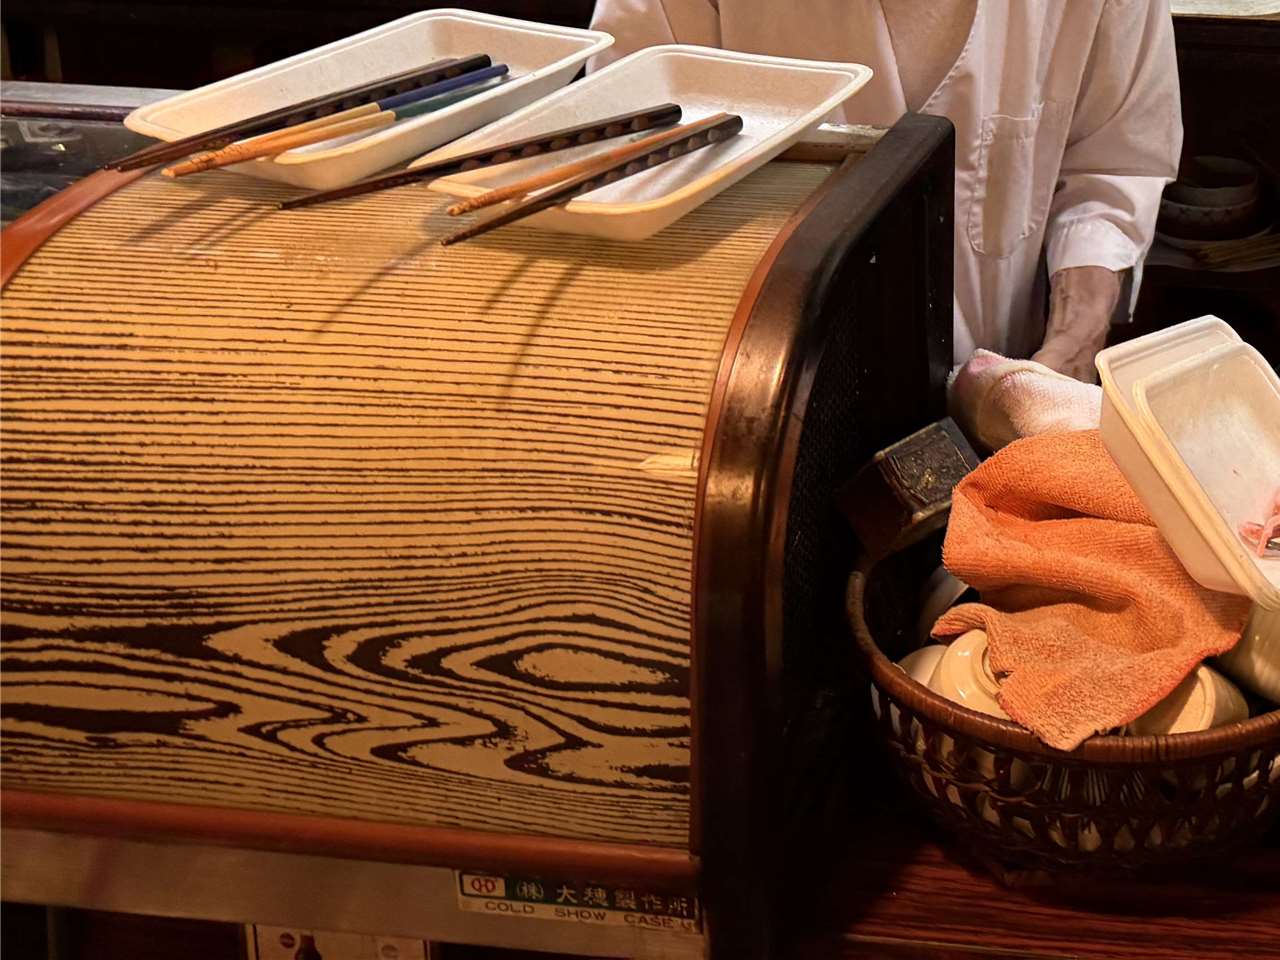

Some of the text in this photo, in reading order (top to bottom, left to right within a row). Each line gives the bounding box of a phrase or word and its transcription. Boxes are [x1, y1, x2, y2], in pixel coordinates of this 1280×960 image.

[484, 900, 536, 916] COLD
[554, 906, 608, 922] SHOW
[623, 912, 676, 929] CASE
